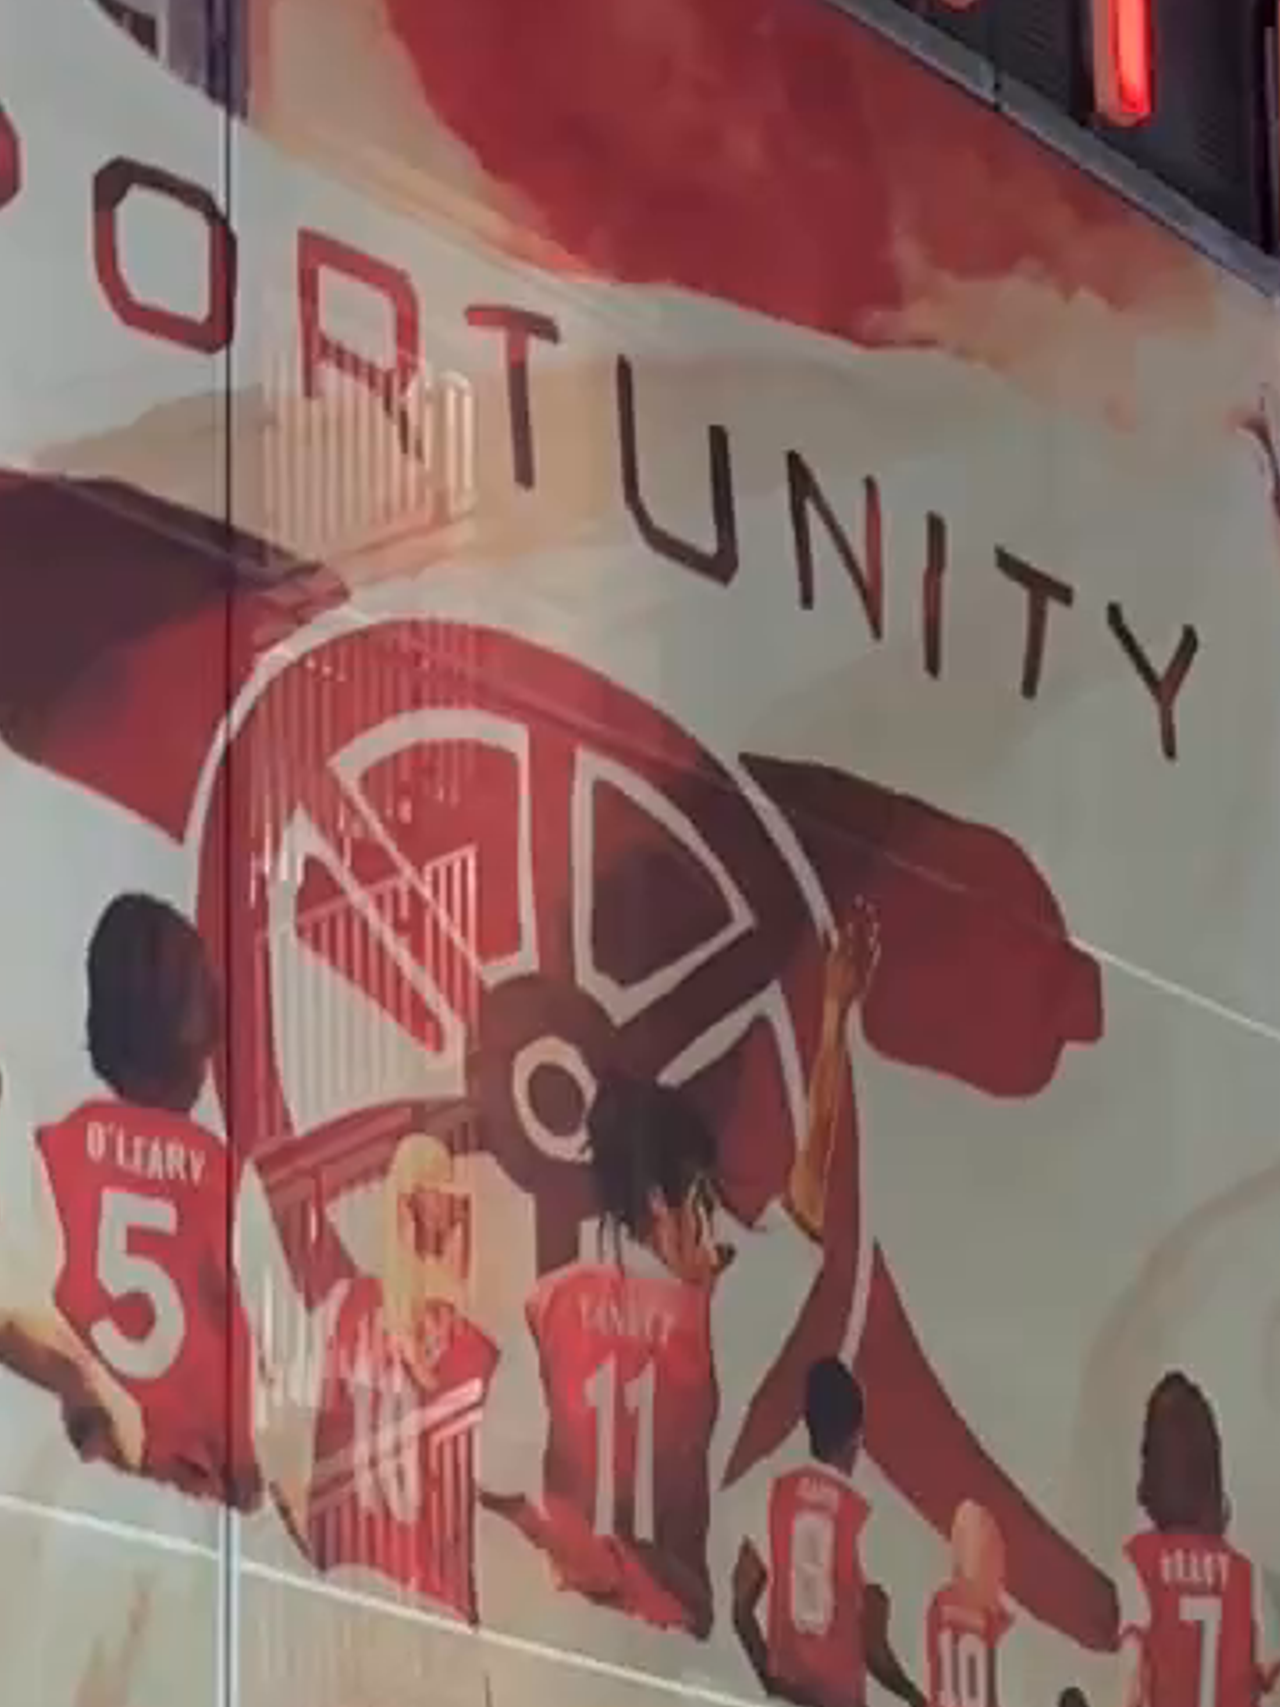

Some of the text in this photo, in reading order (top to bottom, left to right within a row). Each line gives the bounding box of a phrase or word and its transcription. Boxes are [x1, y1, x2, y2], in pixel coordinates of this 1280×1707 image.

[85, 1120, 206, 1185] O'LEARY
[89, 1185, 186, 1379] 5
[582, 1351, 656, 1545] 11
